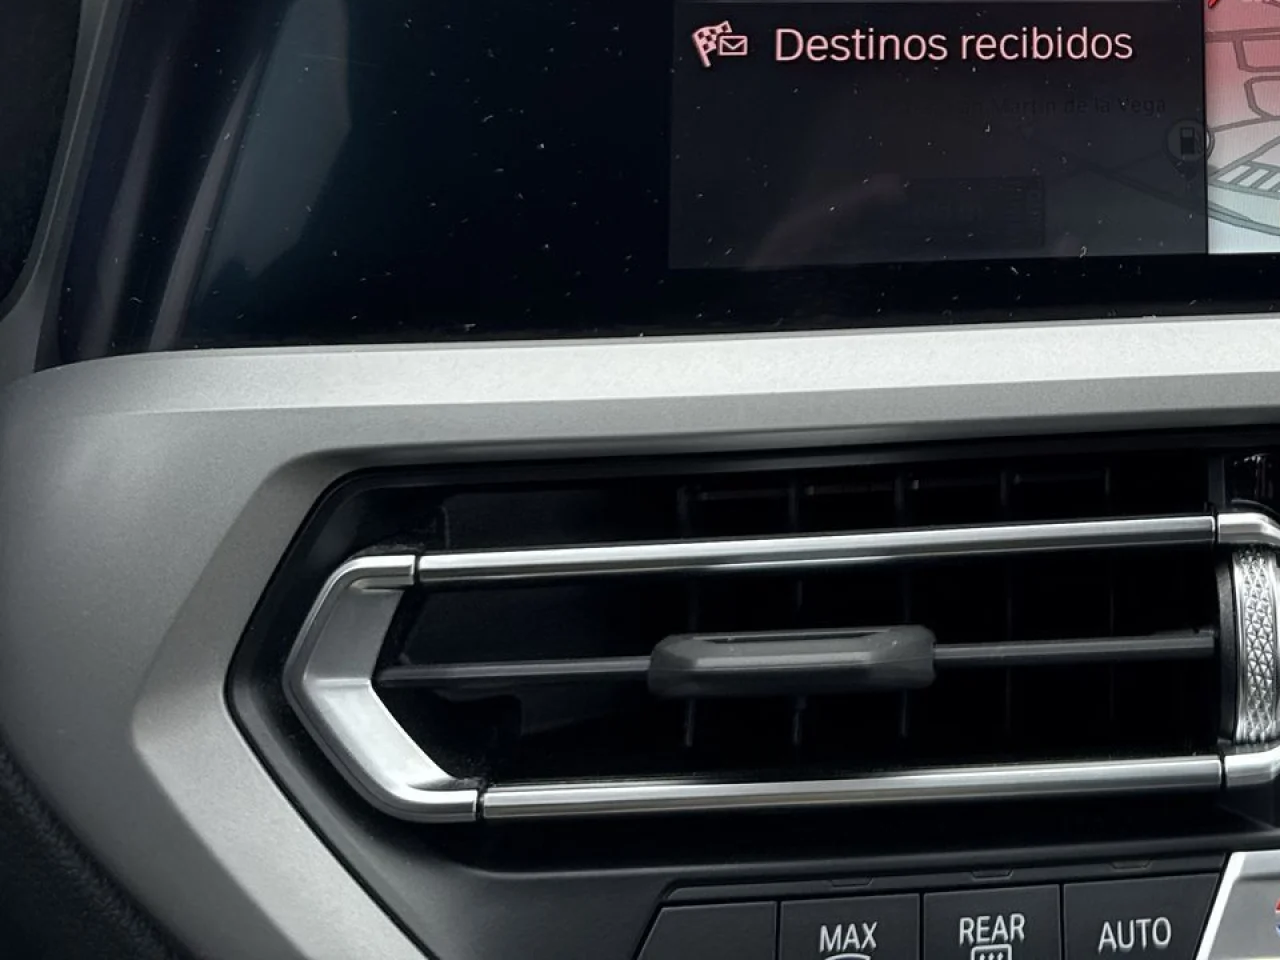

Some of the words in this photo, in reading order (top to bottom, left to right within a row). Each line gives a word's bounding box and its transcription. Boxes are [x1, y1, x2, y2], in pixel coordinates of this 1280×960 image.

[775, 28, 948, 61] Destinos
[961, 27, 1133, 60] recibidos
[820, 921, 877, 952] MAX
[960, 913, 1025, 944] REAR
[1099, 916, 1172, 952] AUTO
